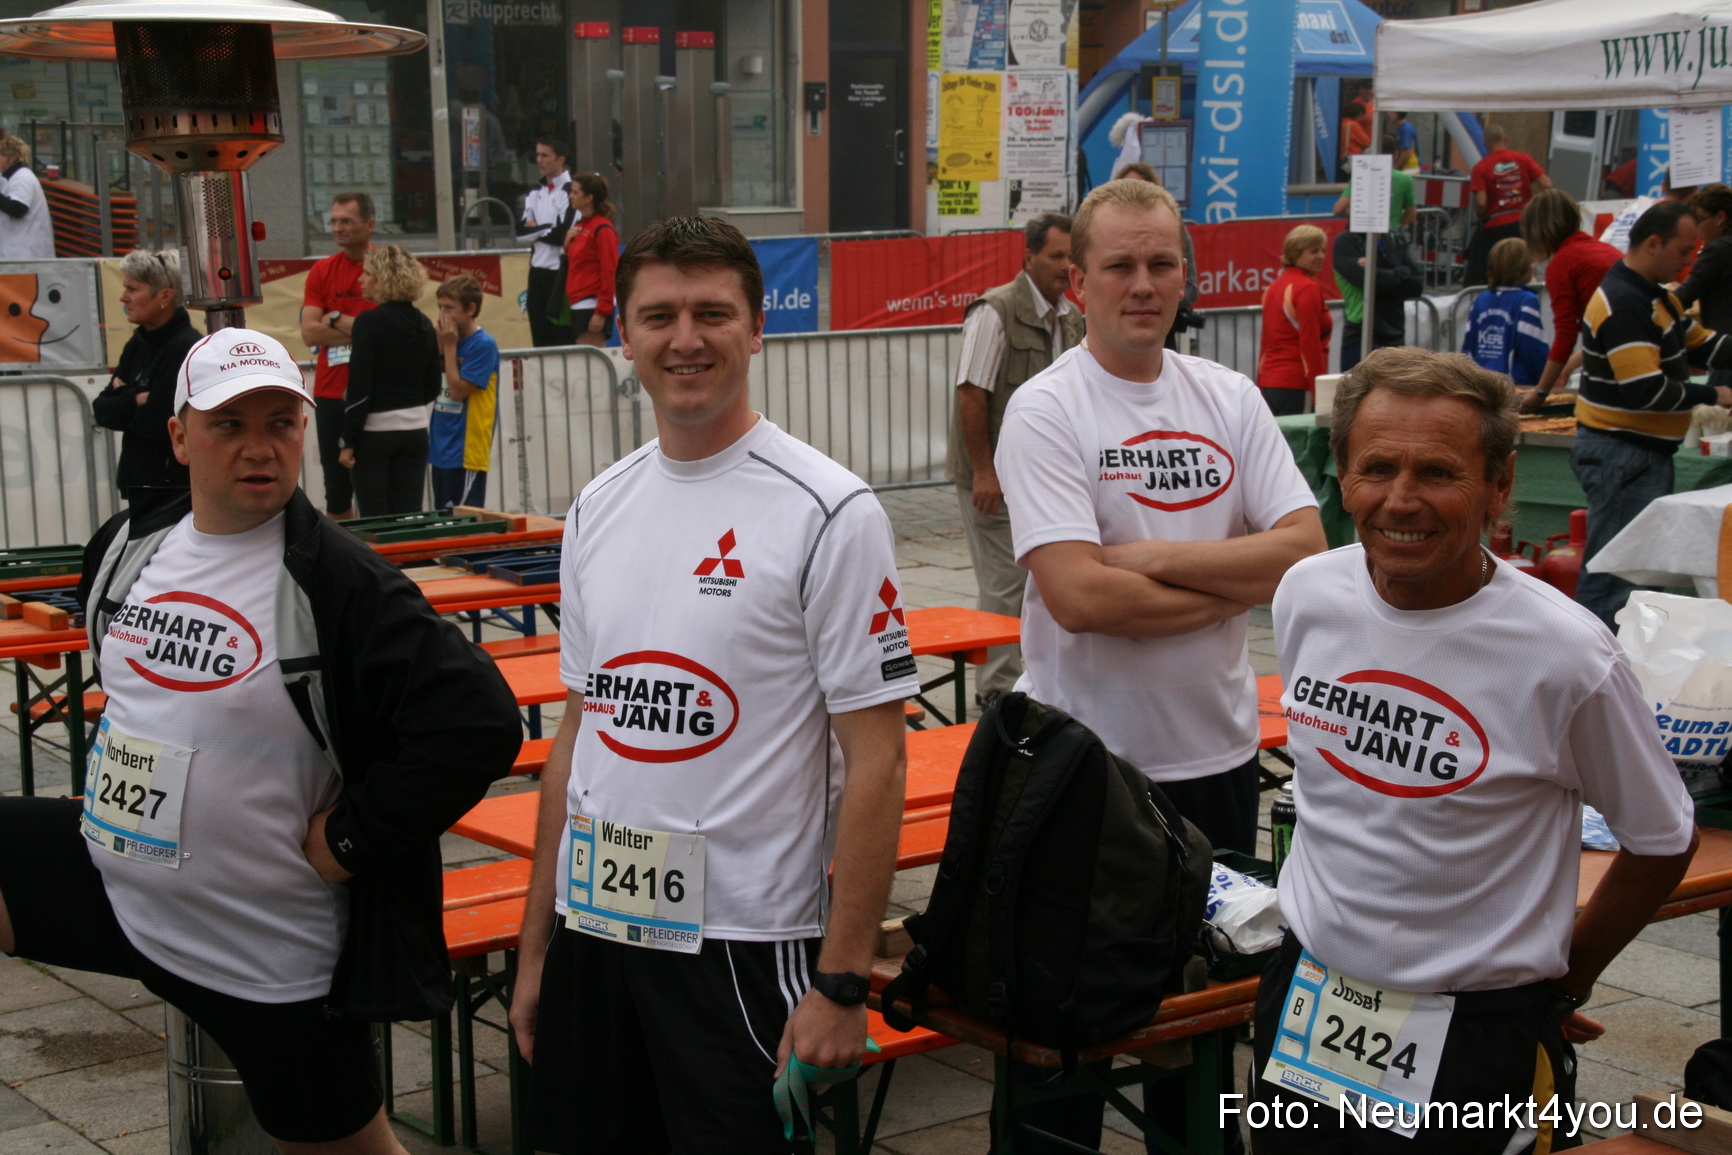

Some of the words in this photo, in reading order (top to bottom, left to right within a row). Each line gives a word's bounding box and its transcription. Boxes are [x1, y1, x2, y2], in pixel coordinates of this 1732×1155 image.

[469, 0, 557, 25] Rupprecht
[1600, 15, 1732, 91] www.ju
[1007, 106, 1032, 117] 100
[1034, 106, 1065, 117] Jahre
[1199, 0, 1249, 224] axi-dsl.d
[886, 291, 947, 313] wenn's
[235, 345, 261, 354] KIA
[219, 362, 237, 372] KIA
[239, 358, 281, 369] MOTORS
[1206, 454, 1216, 464] &
[1144, 468, 1221, 491] JÄNIG
[698, 576, 738, 587] MITSUBISHI
[698, 587, 732, 597] MOTORS
[111, 603, 228, 647] GERHART
[226, 635, 239, 649] &
[145, 637, 236, 677] JÄNIG
[695, 690, 713, 707] &
[612, 703, 715, 737] JÄNIG
[1285, 706, 1348, 736] Autohaus
[1293, 675, 1445, 742] GERHART
[1444, 730, 1461, 748] &
[104, 735, 155, 773] Norbert
[1344, 725, 1459, 780] JÄNIG
[98, 772, 168, 820] 2427
[601, 820, 654, 851] Walter
[126, 839, 178, 859] PFLEIDERER
[576, 848, 584, 866] C
[600, 858, 686, 904] 2416
[642, 926, 699, 945] PFLEIDERER
[1292, 996, 1305, 1017] B
[1331, 976, 1384, 1013] Josef
[1320, 1014, 1418, 1080] 2424
[1281, 1069, 1322, 1092] BOCK
